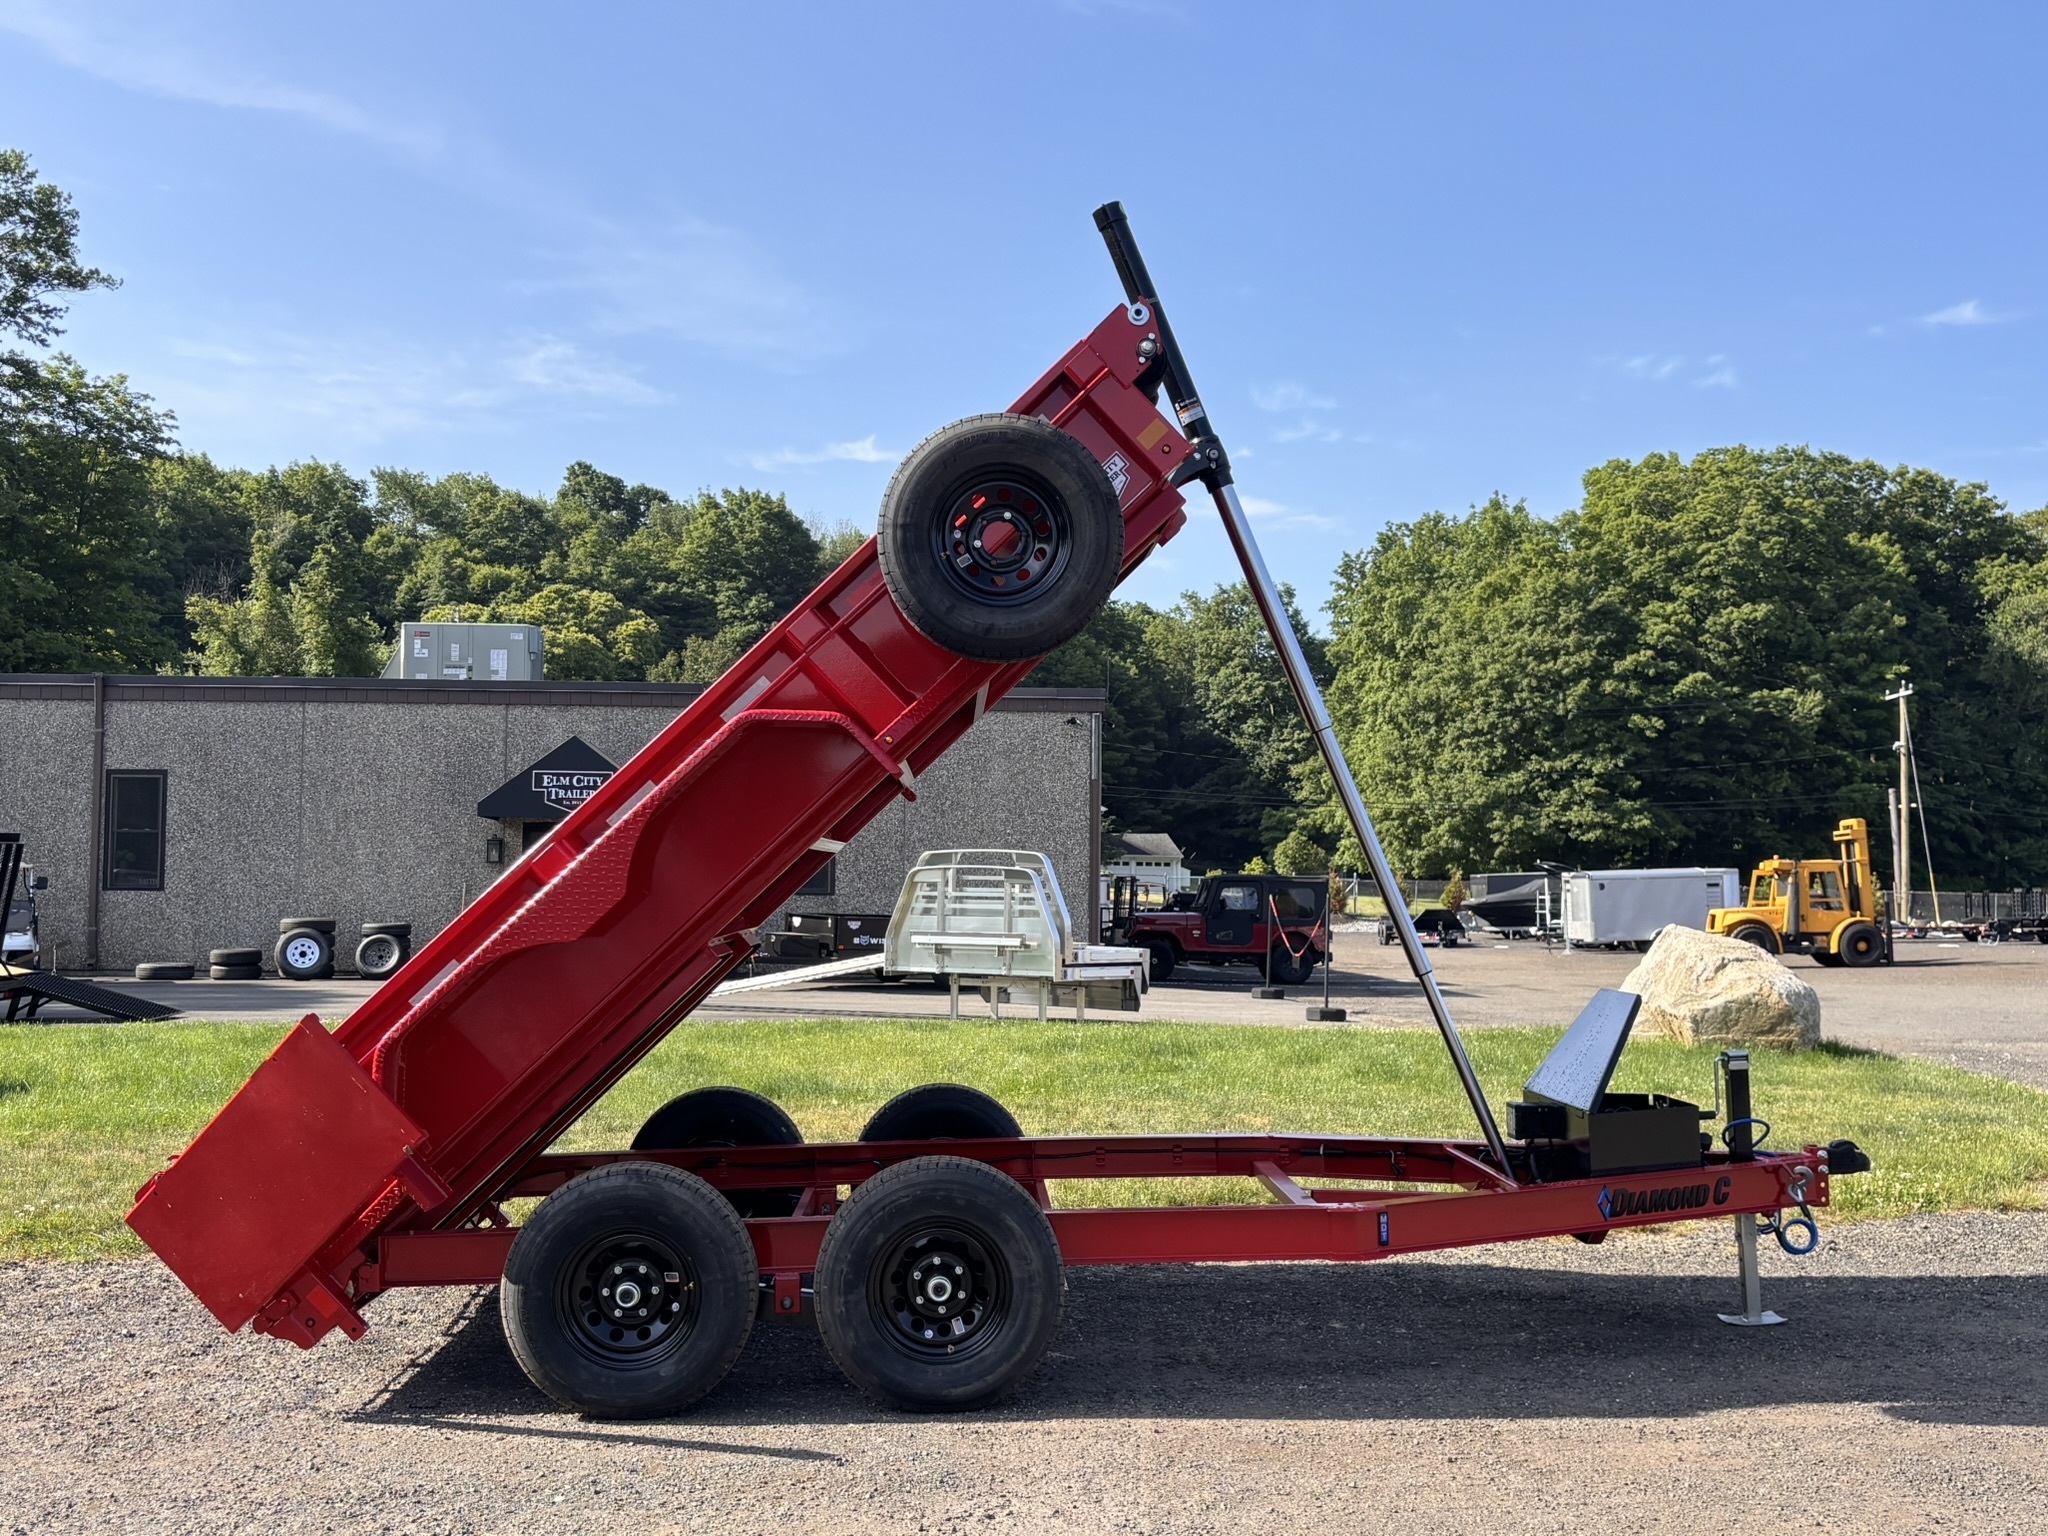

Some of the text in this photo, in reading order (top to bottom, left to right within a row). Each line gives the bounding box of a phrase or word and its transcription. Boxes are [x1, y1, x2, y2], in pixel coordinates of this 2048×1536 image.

[542, 774, 604, 787] ELM CITY
[1609, 1176, 1731, 1218] DIAMOND C
